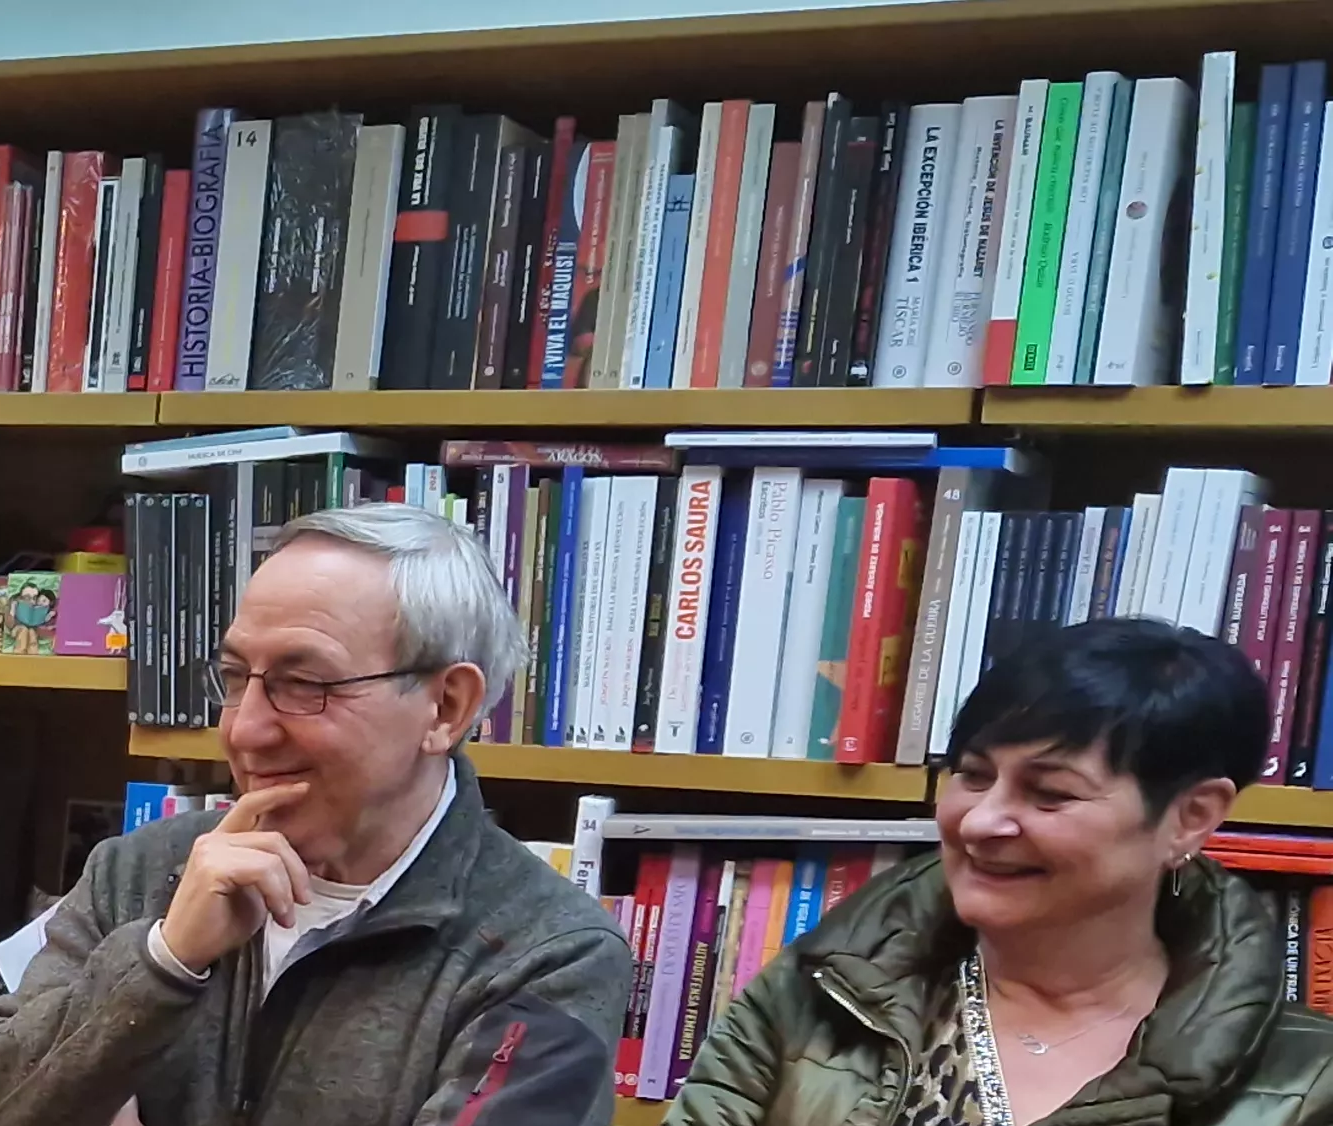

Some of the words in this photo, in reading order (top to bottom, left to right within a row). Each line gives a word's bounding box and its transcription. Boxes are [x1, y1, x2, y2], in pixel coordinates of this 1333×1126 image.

[236, 130, 257, 148] 14
[925, 126, 941, 143] LA
[994, 119, 1005, 130] LA
[987, 133, 1003, 179] INVENCIÓN
[411, 192, 421, 205] LA
[914, 146, 938, 219] EXCEPCIÓN
[984, 181, 996, 194] DE
[1068, 251, 1080, 275] JARA
[1079, 186, 1089, 203] LOS
[1089, 120, 1099, 133] DE
[907, 222, 929, 273] IBÉRICA
[979, 224, 991, 237] DE
[973, 238, 988, 279] NAZARET
[551, 255, 574, 310] MAQUIS!
[546, 314, 567, 330] EL
[889, 295, 910, 348] TÍSCAR
[544, 333, 565, 368] ¡VIVA
[188, 452, 215, 460] HUESCA
[547, 450, 603, 463] ARAGÓN
[758, 481, 771, 519] Escritos
[770, 482, 788, 522] Pablo
[943, 489, 960, 500] 48
[613, 501, 625, 553] REVOLUCIÓN
[635, 501, 647, 554] REVOLUCIÓN
[684, 480, 712, 553] SAURA
[762, 529, 783, 580] Picasso
[1265, 564, 1275, 573] LA
[1295, 564, 1304, 574] LA
[865, 555, 879, 589] ÁLVAREZ
[1264, 574, 1273, 583] DE
[1293, 575, 1303, 584] DE
[675, 558, 704, 640] CARLOS
[862, 591, 874, 618] PEDRO
[1232, 572, 1248, 620] ILUSTRADA
[1289, 585, 1301, 620] LITERARIO
[588, 596, 598, 634] HISTORIA
[924, 599, 941, 644] GUERRA
[1257, 619, 1267, 641] ATLAS
[1286, 620, 1297, 642] ATLAS
[1228, 622, 1239, 644] GUÍA
[916, 666, 930, 679] DE
[921, 648, 933, 663] LA
[582, 819, 597, 832] 34
[687, 941, 709, 1008] AUTODEFENSA
[678, 1008, 700, 1060] FEMINISTA
